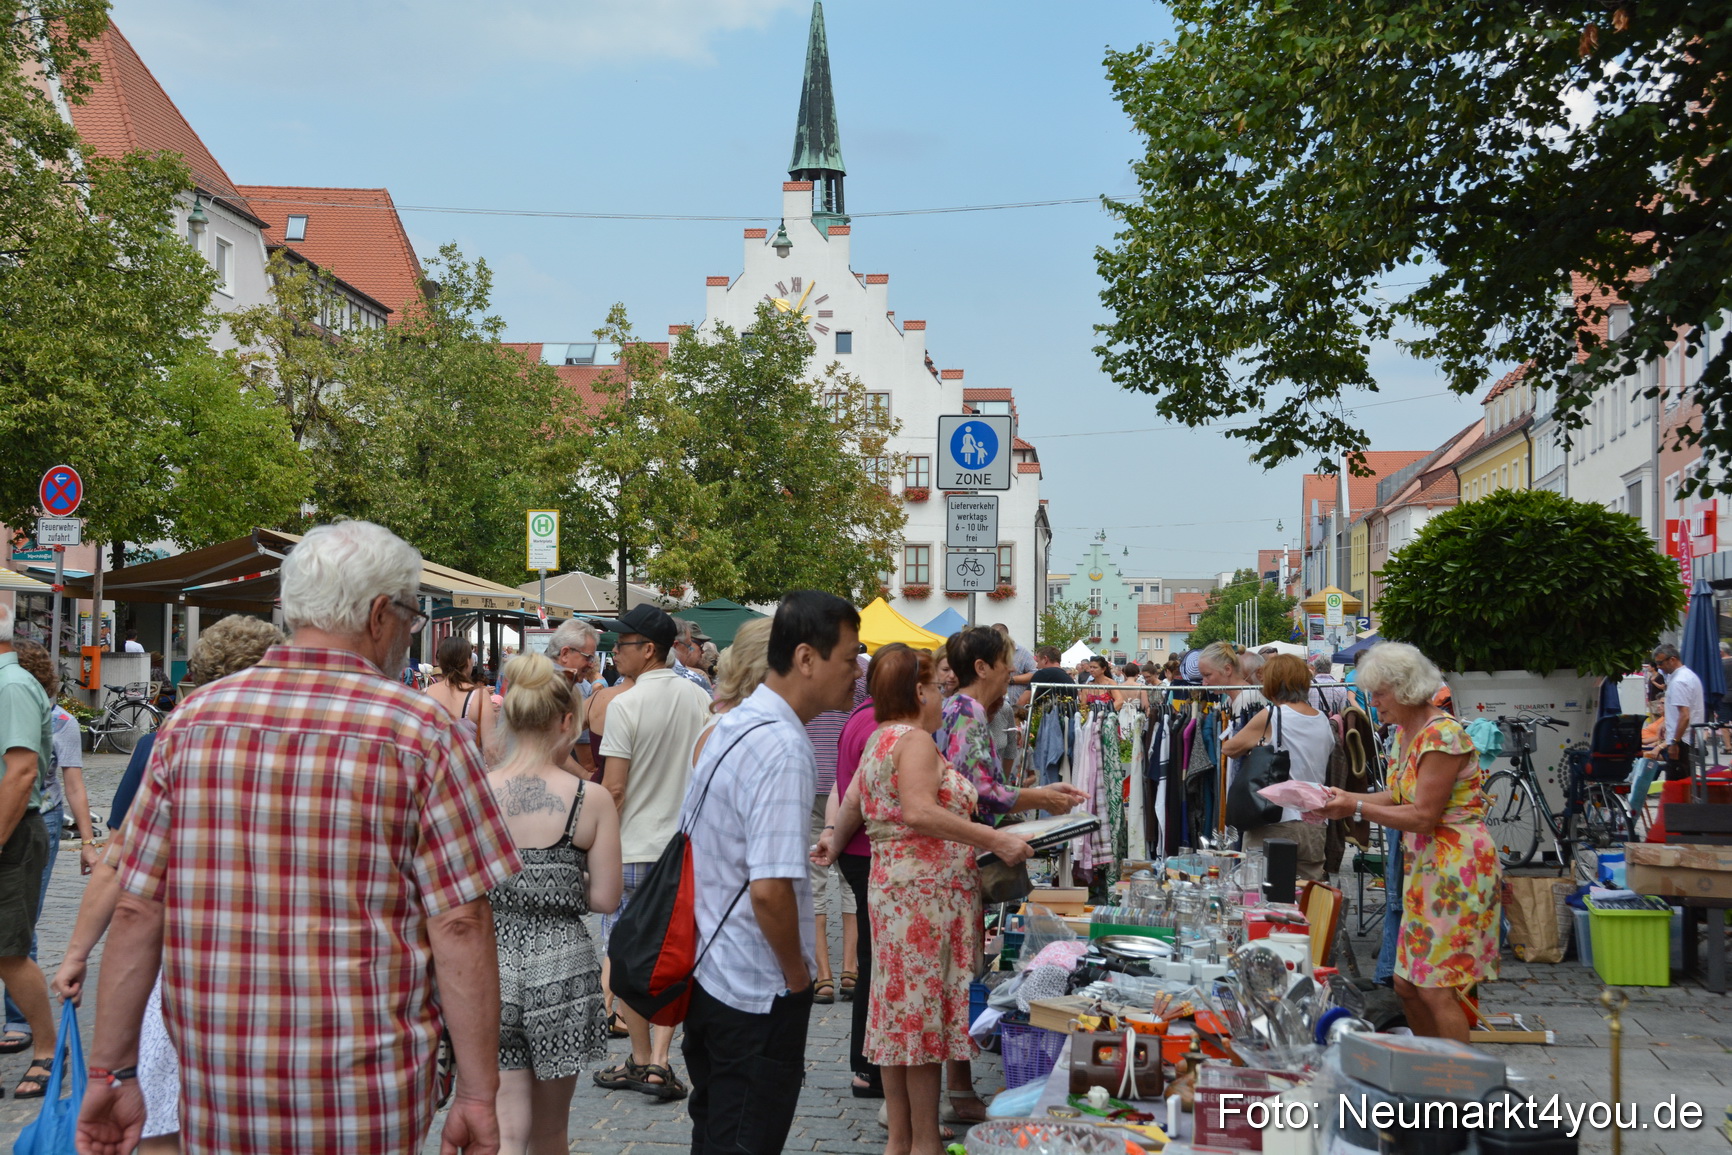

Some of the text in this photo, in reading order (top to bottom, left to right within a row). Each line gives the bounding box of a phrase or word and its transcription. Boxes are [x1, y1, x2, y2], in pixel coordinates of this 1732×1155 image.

[955, 473, 992, 485] ZONE
[950, 501, 995, 511] Lieferverkehr
[957, 513, 988, 522] werktags
[41, 522, 77, 532] Feuerwehr-
[537, 519, 549, 532] H
[955, 523, 960, 532] 6
[967, 523, 976, 532] 10
[977, 523, 989, 532] Uhr
[47, 533, 71, 542] zufahrt
[965, 533, 978, 542] frei
[962, 578, 979, 587] frei
